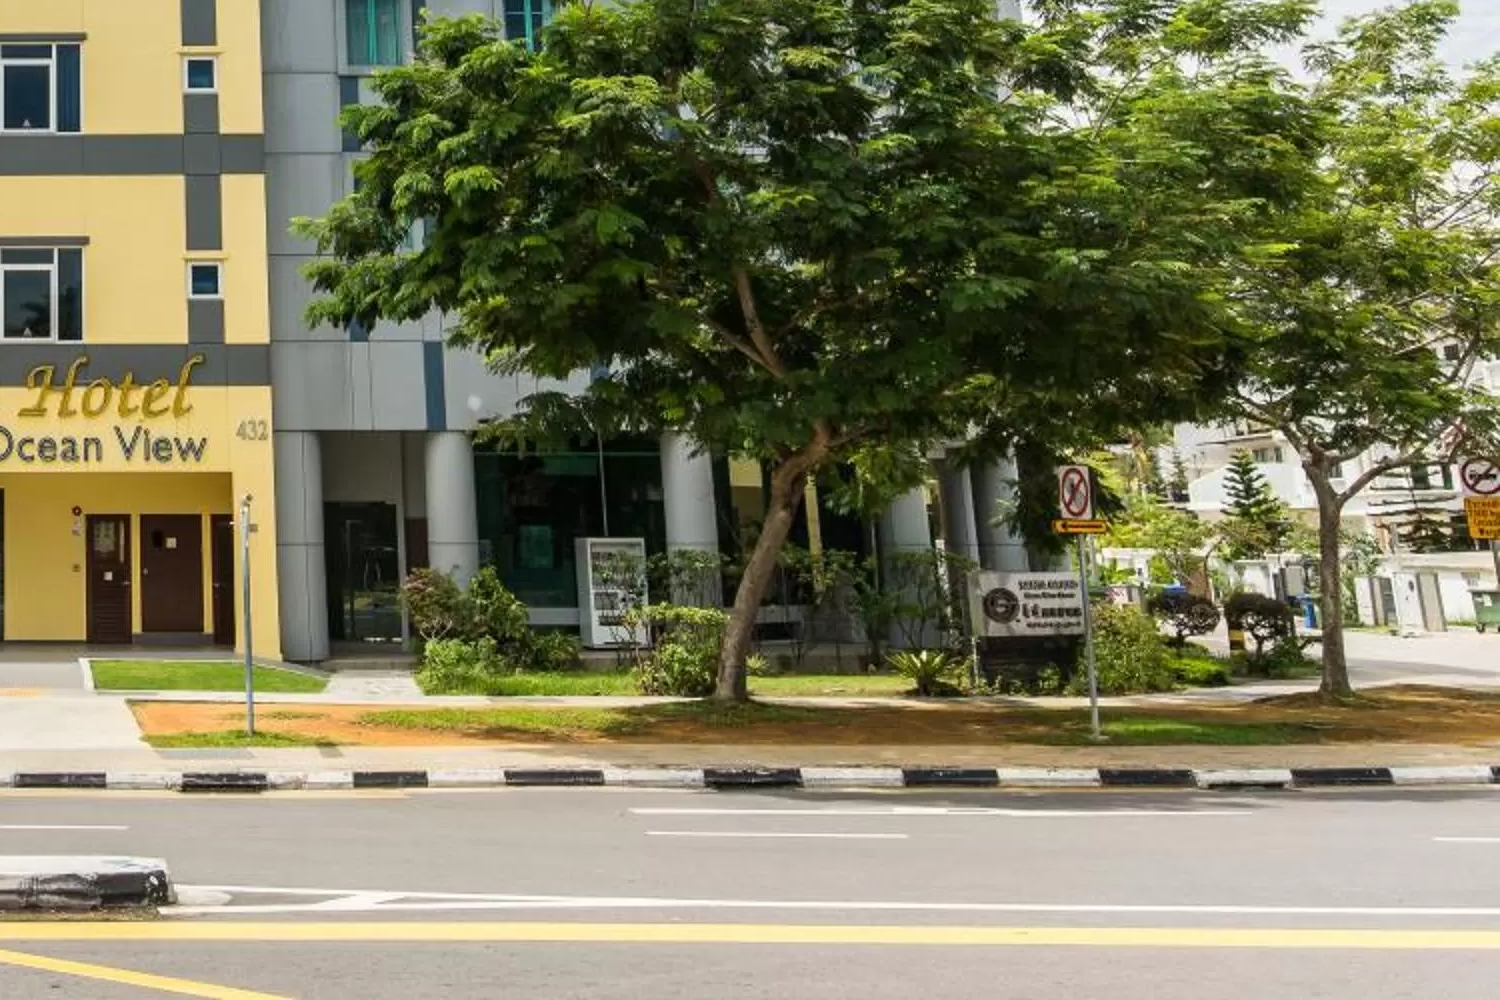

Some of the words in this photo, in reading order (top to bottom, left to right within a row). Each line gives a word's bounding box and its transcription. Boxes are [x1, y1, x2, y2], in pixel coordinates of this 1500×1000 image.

[17, 354, 206, 418] Hotel
[113, 424, 208, 463] View
[235, 419, 269, 442] 432
